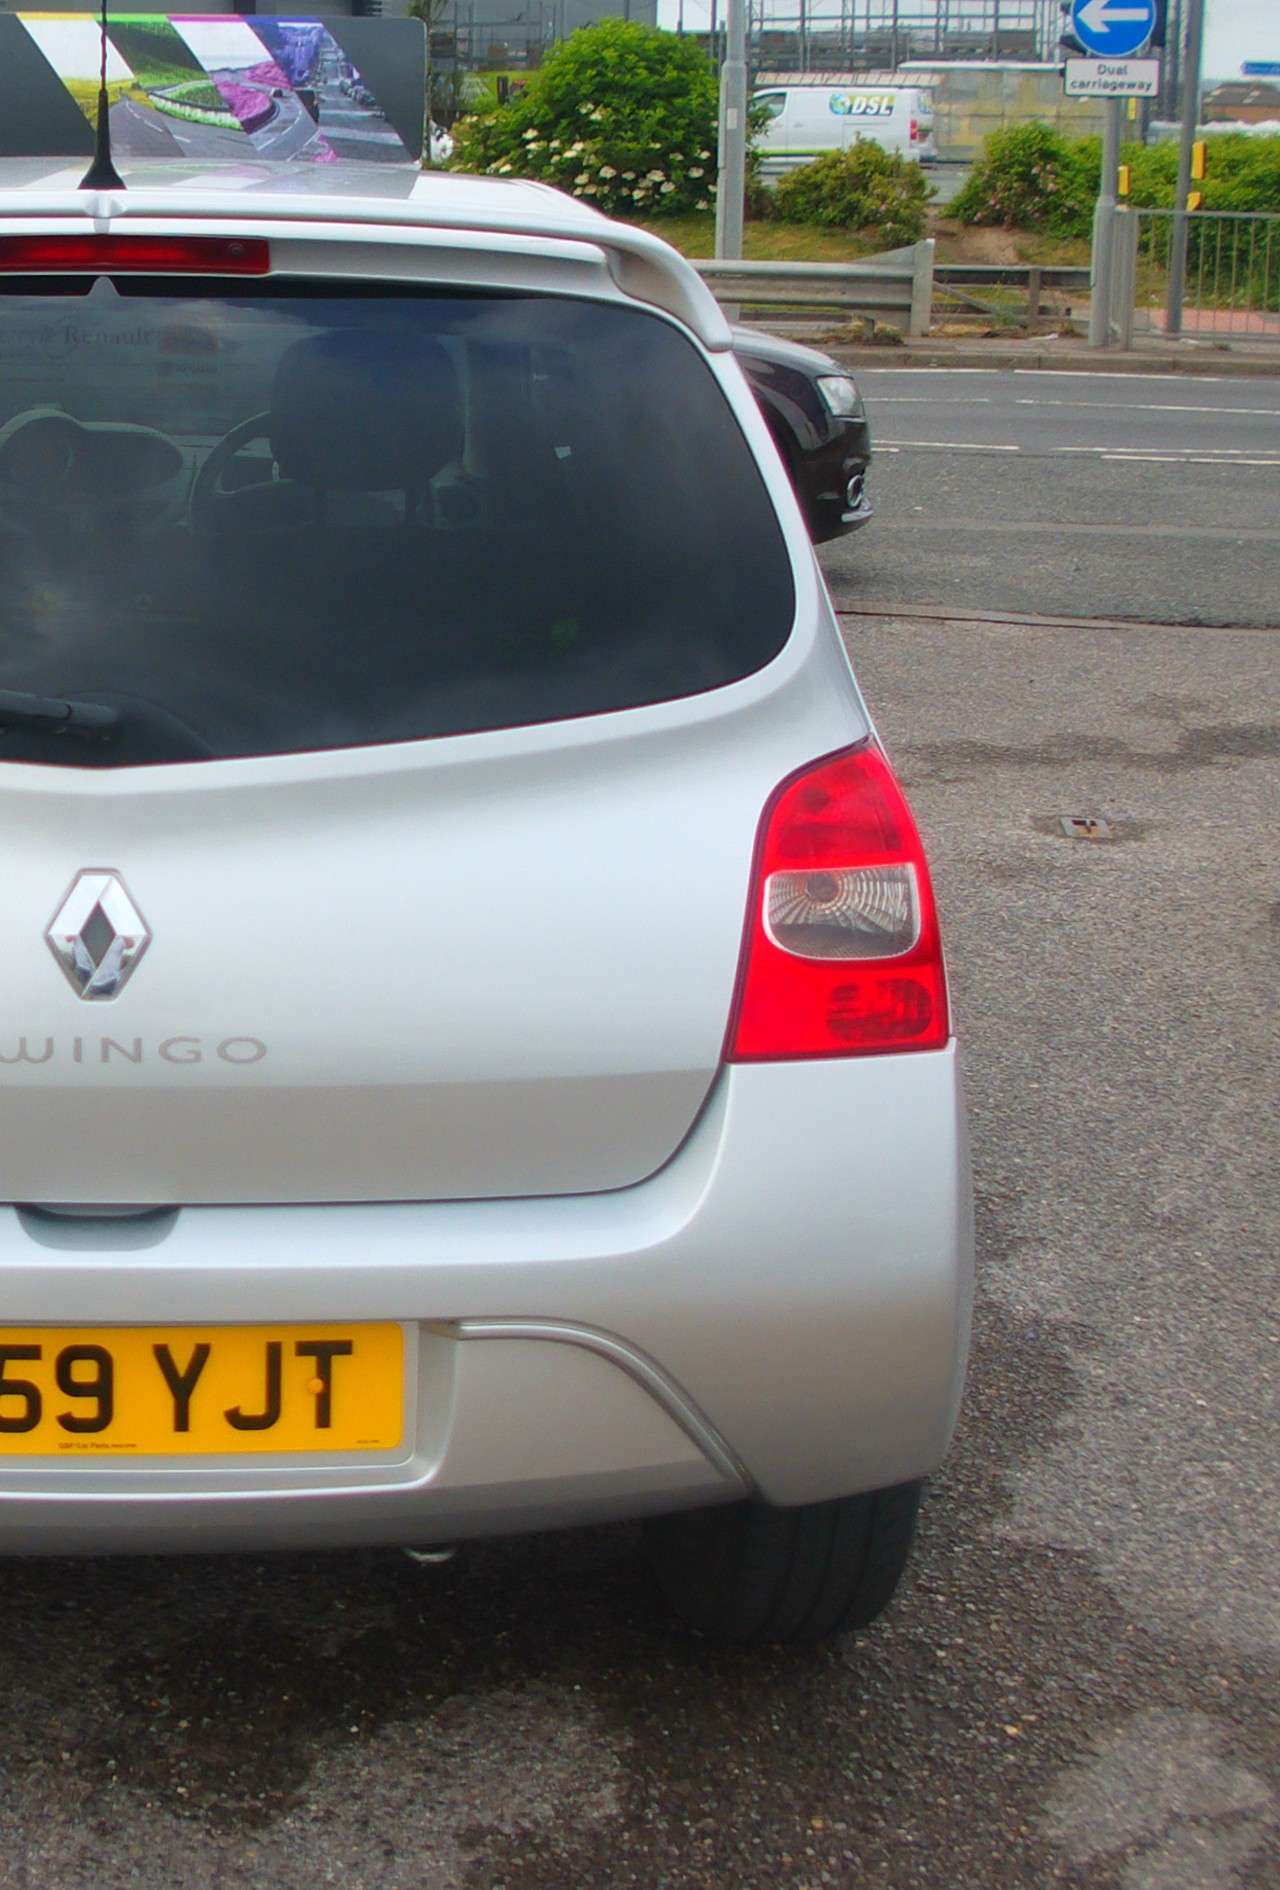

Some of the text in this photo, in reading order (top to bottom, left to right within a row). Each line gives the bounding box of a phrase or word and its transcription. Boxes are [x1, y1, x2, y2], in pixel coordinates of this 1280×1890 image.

[1096, 64, 1128, 75] Dual
[1070, 79, 1153, 92] carriageway
[850, 94, 893, 115] DSL
[151, 1340, 353, 1432] YJT
